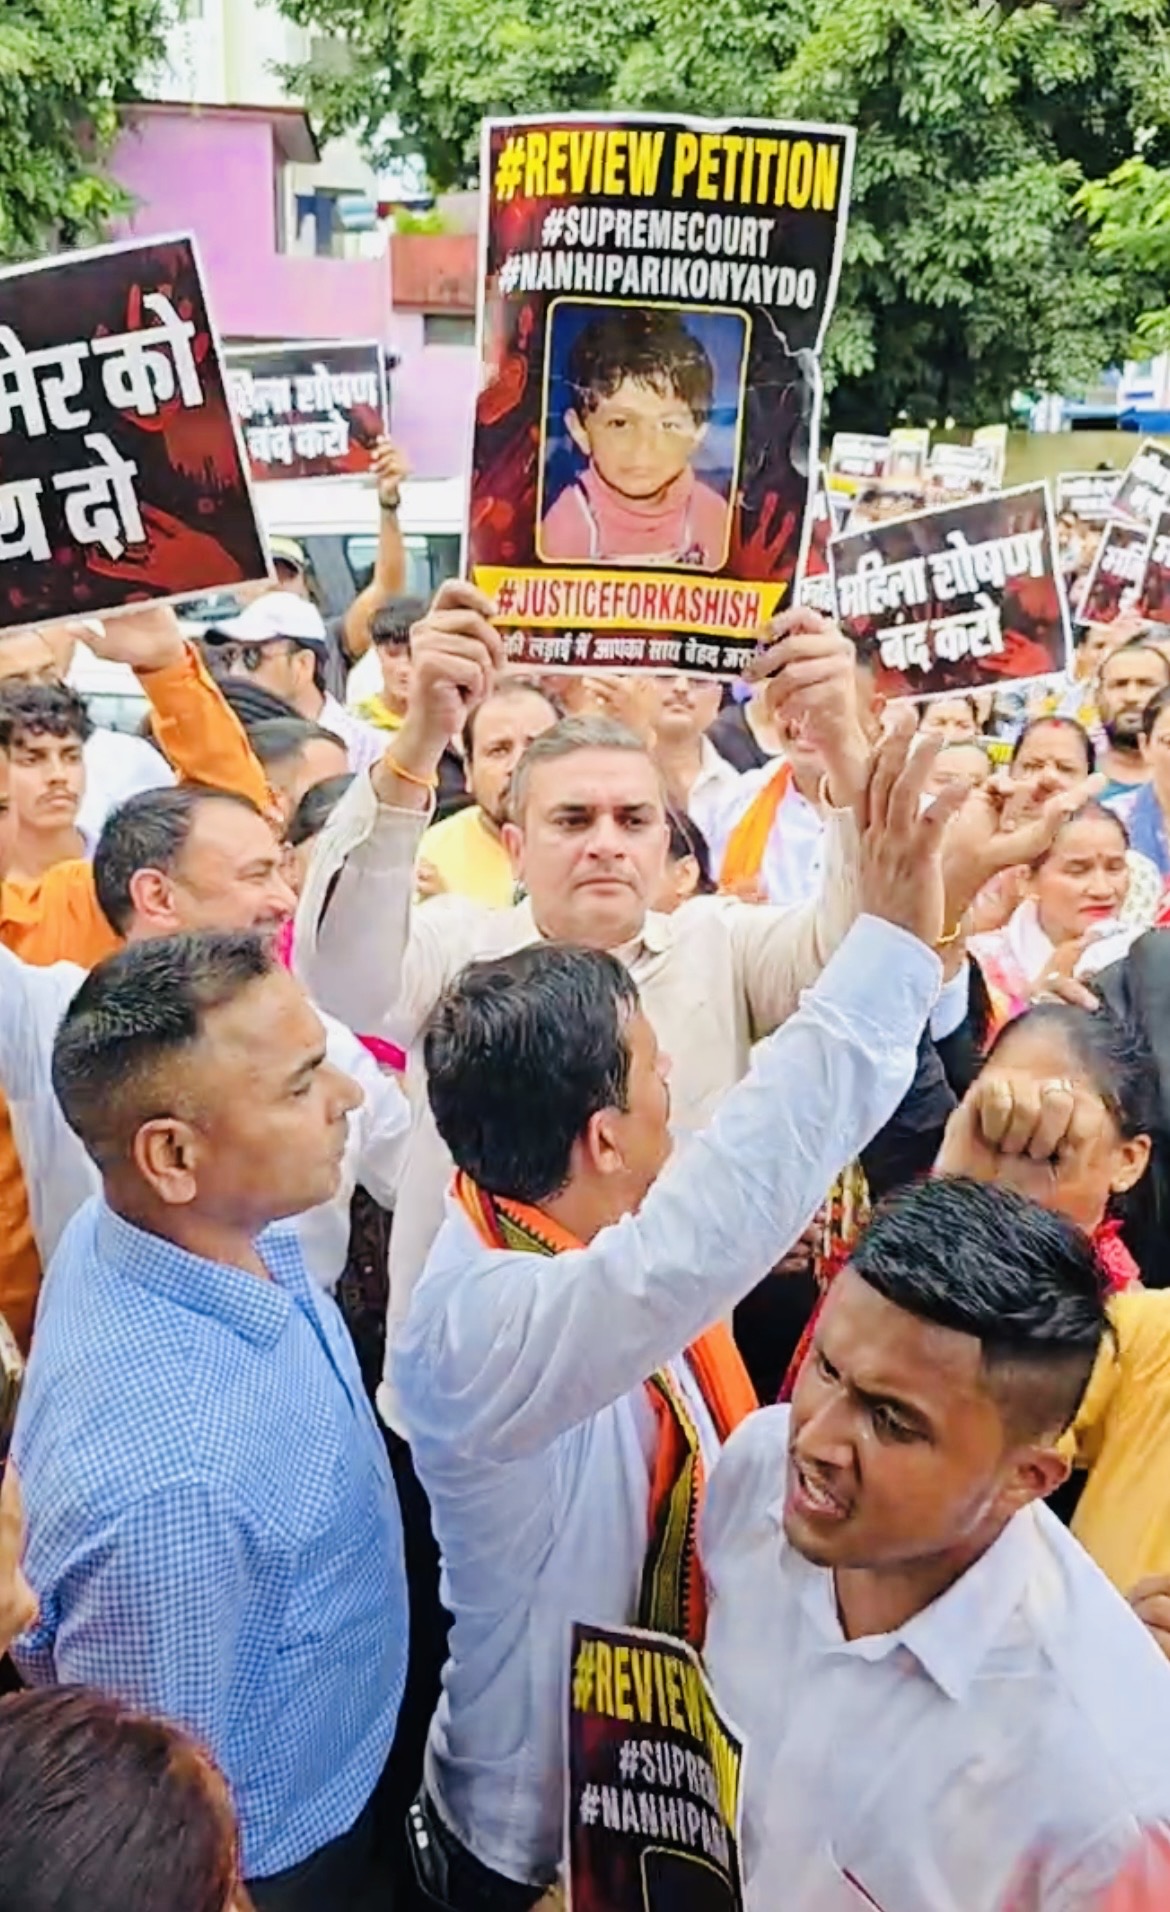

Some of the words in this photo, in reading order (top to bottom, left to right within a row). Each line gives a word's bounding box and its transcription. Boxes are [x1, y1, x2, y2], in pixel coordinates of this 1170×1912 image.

[494, 131, 664, 200] #REVIEW
[672, 134, 839, 211] PETITION
[541, 206, 775, 259] #SUPREMECOURT
[498, 251, 817, 310] #NANHIPARIKONYAYDO
[90, 293, 204, 416] को
[52, 432, 147, 560] दो
[497, 579, 760, 629] #JUSTICEFORKASHISH
[836, 550, 929, 619] महिला
[928, 530, 1044, 600] शोषण
[876, 611, 933, 673] बंद
[933, 597, 1005, 662] करो
